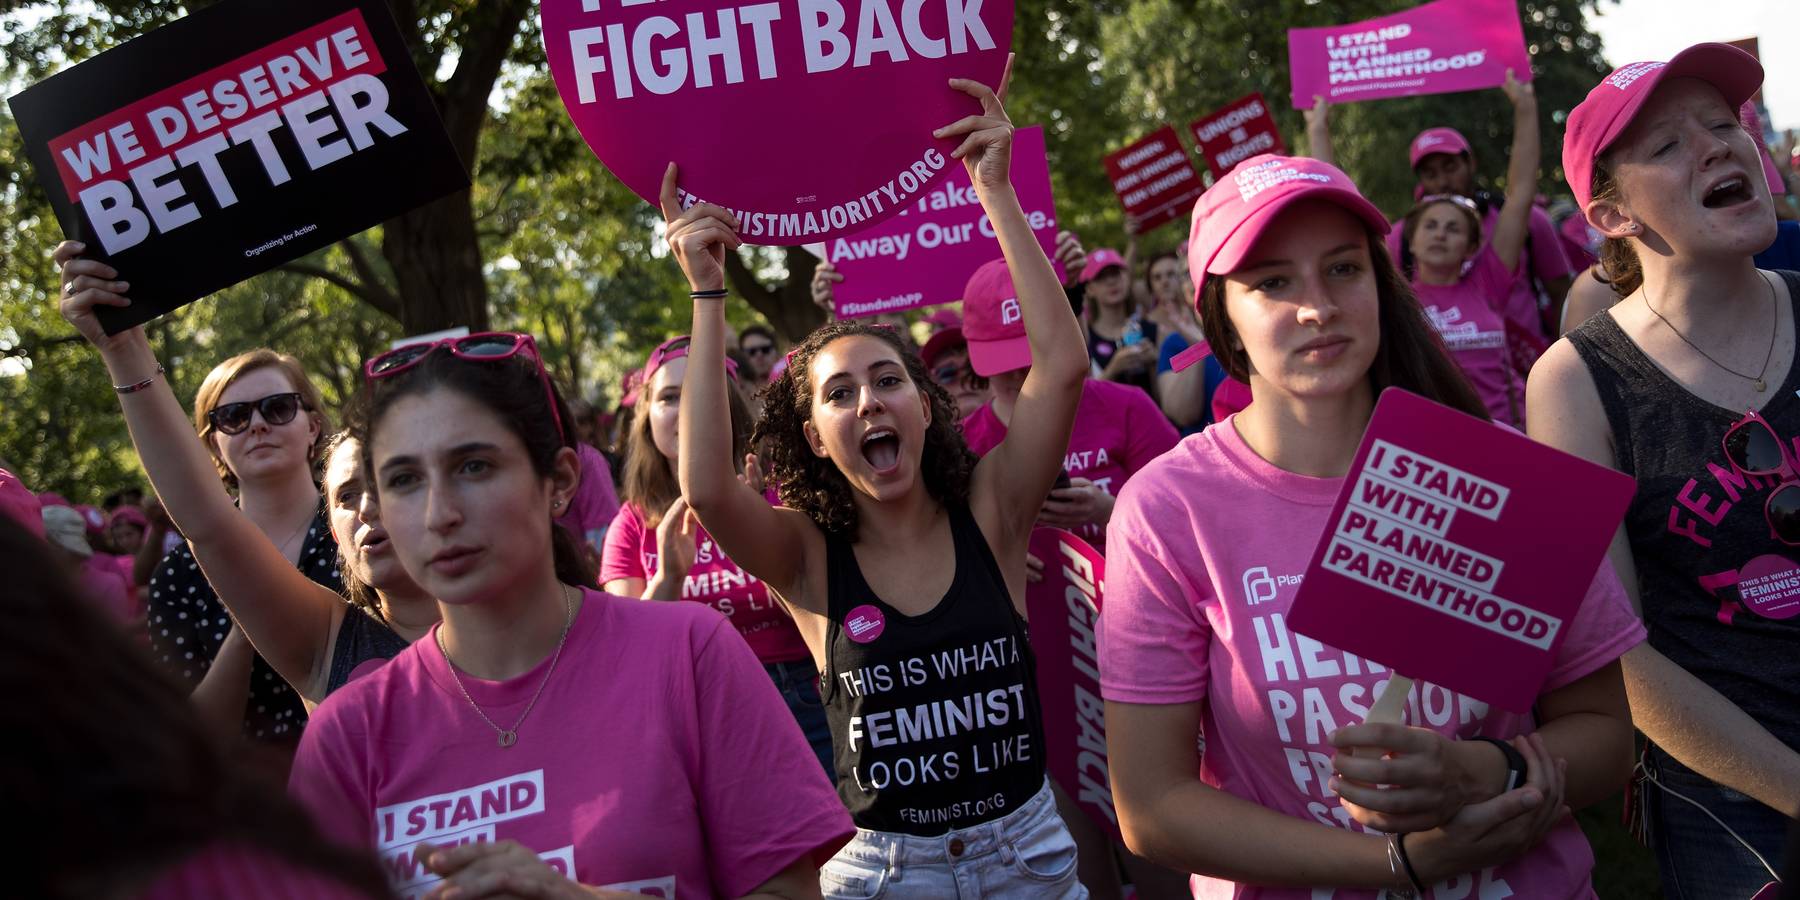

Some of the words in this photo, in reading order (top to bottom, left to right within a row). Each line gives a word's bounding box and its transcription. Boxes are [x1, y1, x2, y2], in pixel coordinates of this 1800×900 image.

[569, 2, 781, 104] FIGHT
[799, 0, 997, 74] BACK
[1326, 36, 1335, 48] I
[1338, 23, 1412, 48] STAND
[1328, 42, 1388, 60] WITH
[1328, 48, 1432, 73] PLANNED
[1329, 51, 1485, 85] PARENTHOOD
[62, 120, 146, 183] WE
[146, 25, 370, 149] DESERVE
[1197, 100, 1265, 143] UNIONS
[79, 73, 409, 256] BETTER
[1215, 131, 1274, 169] RIGHTS
[245, 238, 285, 257] Organizing
[283, 234, 294, 242] for
[294, 223, 318, 237] Action
[832, 232, 911, 261] Away
[916, 222, 974, 249] Our
[978, 210, 1055, 239] Ce.
[841, 292, 923, 315] #StandwithPP
[1095, 447, 1109, 466] A
[1370, 446, 1386, 470] I
[1389, 454, 1500, 511] STAND
[1361, 478, 1449, 531] WITH
[1342, 510, 1494, 584] PLANNED
[1328, 542, 1550, 640] PARENTHOOD
[1740, 578, 1760, 588] THIS
[1770, 569, 1793, 580] WHAT
[1754, 592, 1783, 604] LOOKS
[839, 664, 894, 698] THIS
[899, 657, 928, 687] IS
[931, 637, 1007, 680] WHAT
[1010, 634, 1019, 664] A
[849, 683, 1024, 753] FEMINIST
[853, 751, 959, 792] LOOKS
[973, 733, 1030, 773] LIKE
[384, 812, 395, 843] I
[405, 780, 538, 837] STAND
[900, 792, 1005, 824] FEMINIST.ORG
